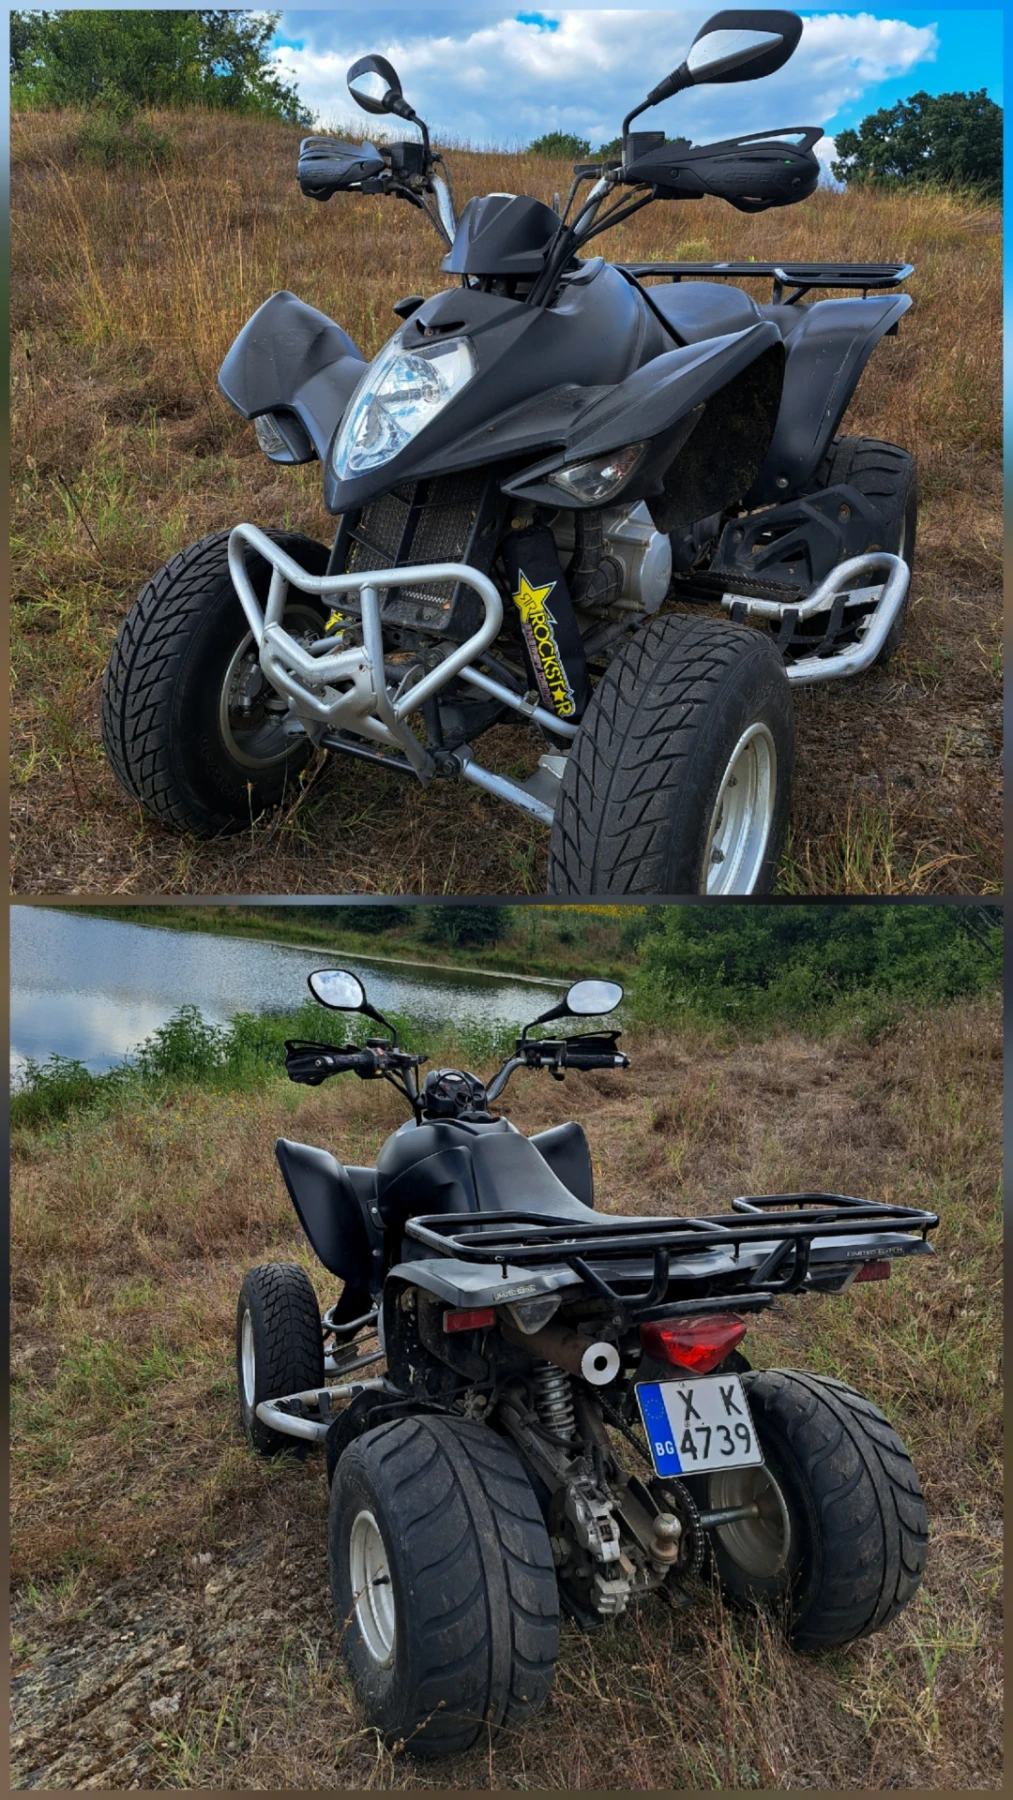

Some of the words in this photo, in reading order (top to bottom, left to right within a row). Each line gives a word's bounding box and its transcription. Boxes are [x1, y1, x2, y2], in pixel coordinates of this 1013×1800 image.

[677, 1389, 701, 1420] X
[719, 1385, 743, 1416] K
[655, 1441, 675, 1456] BG
[680, 1423, 751, 1460] 4739
